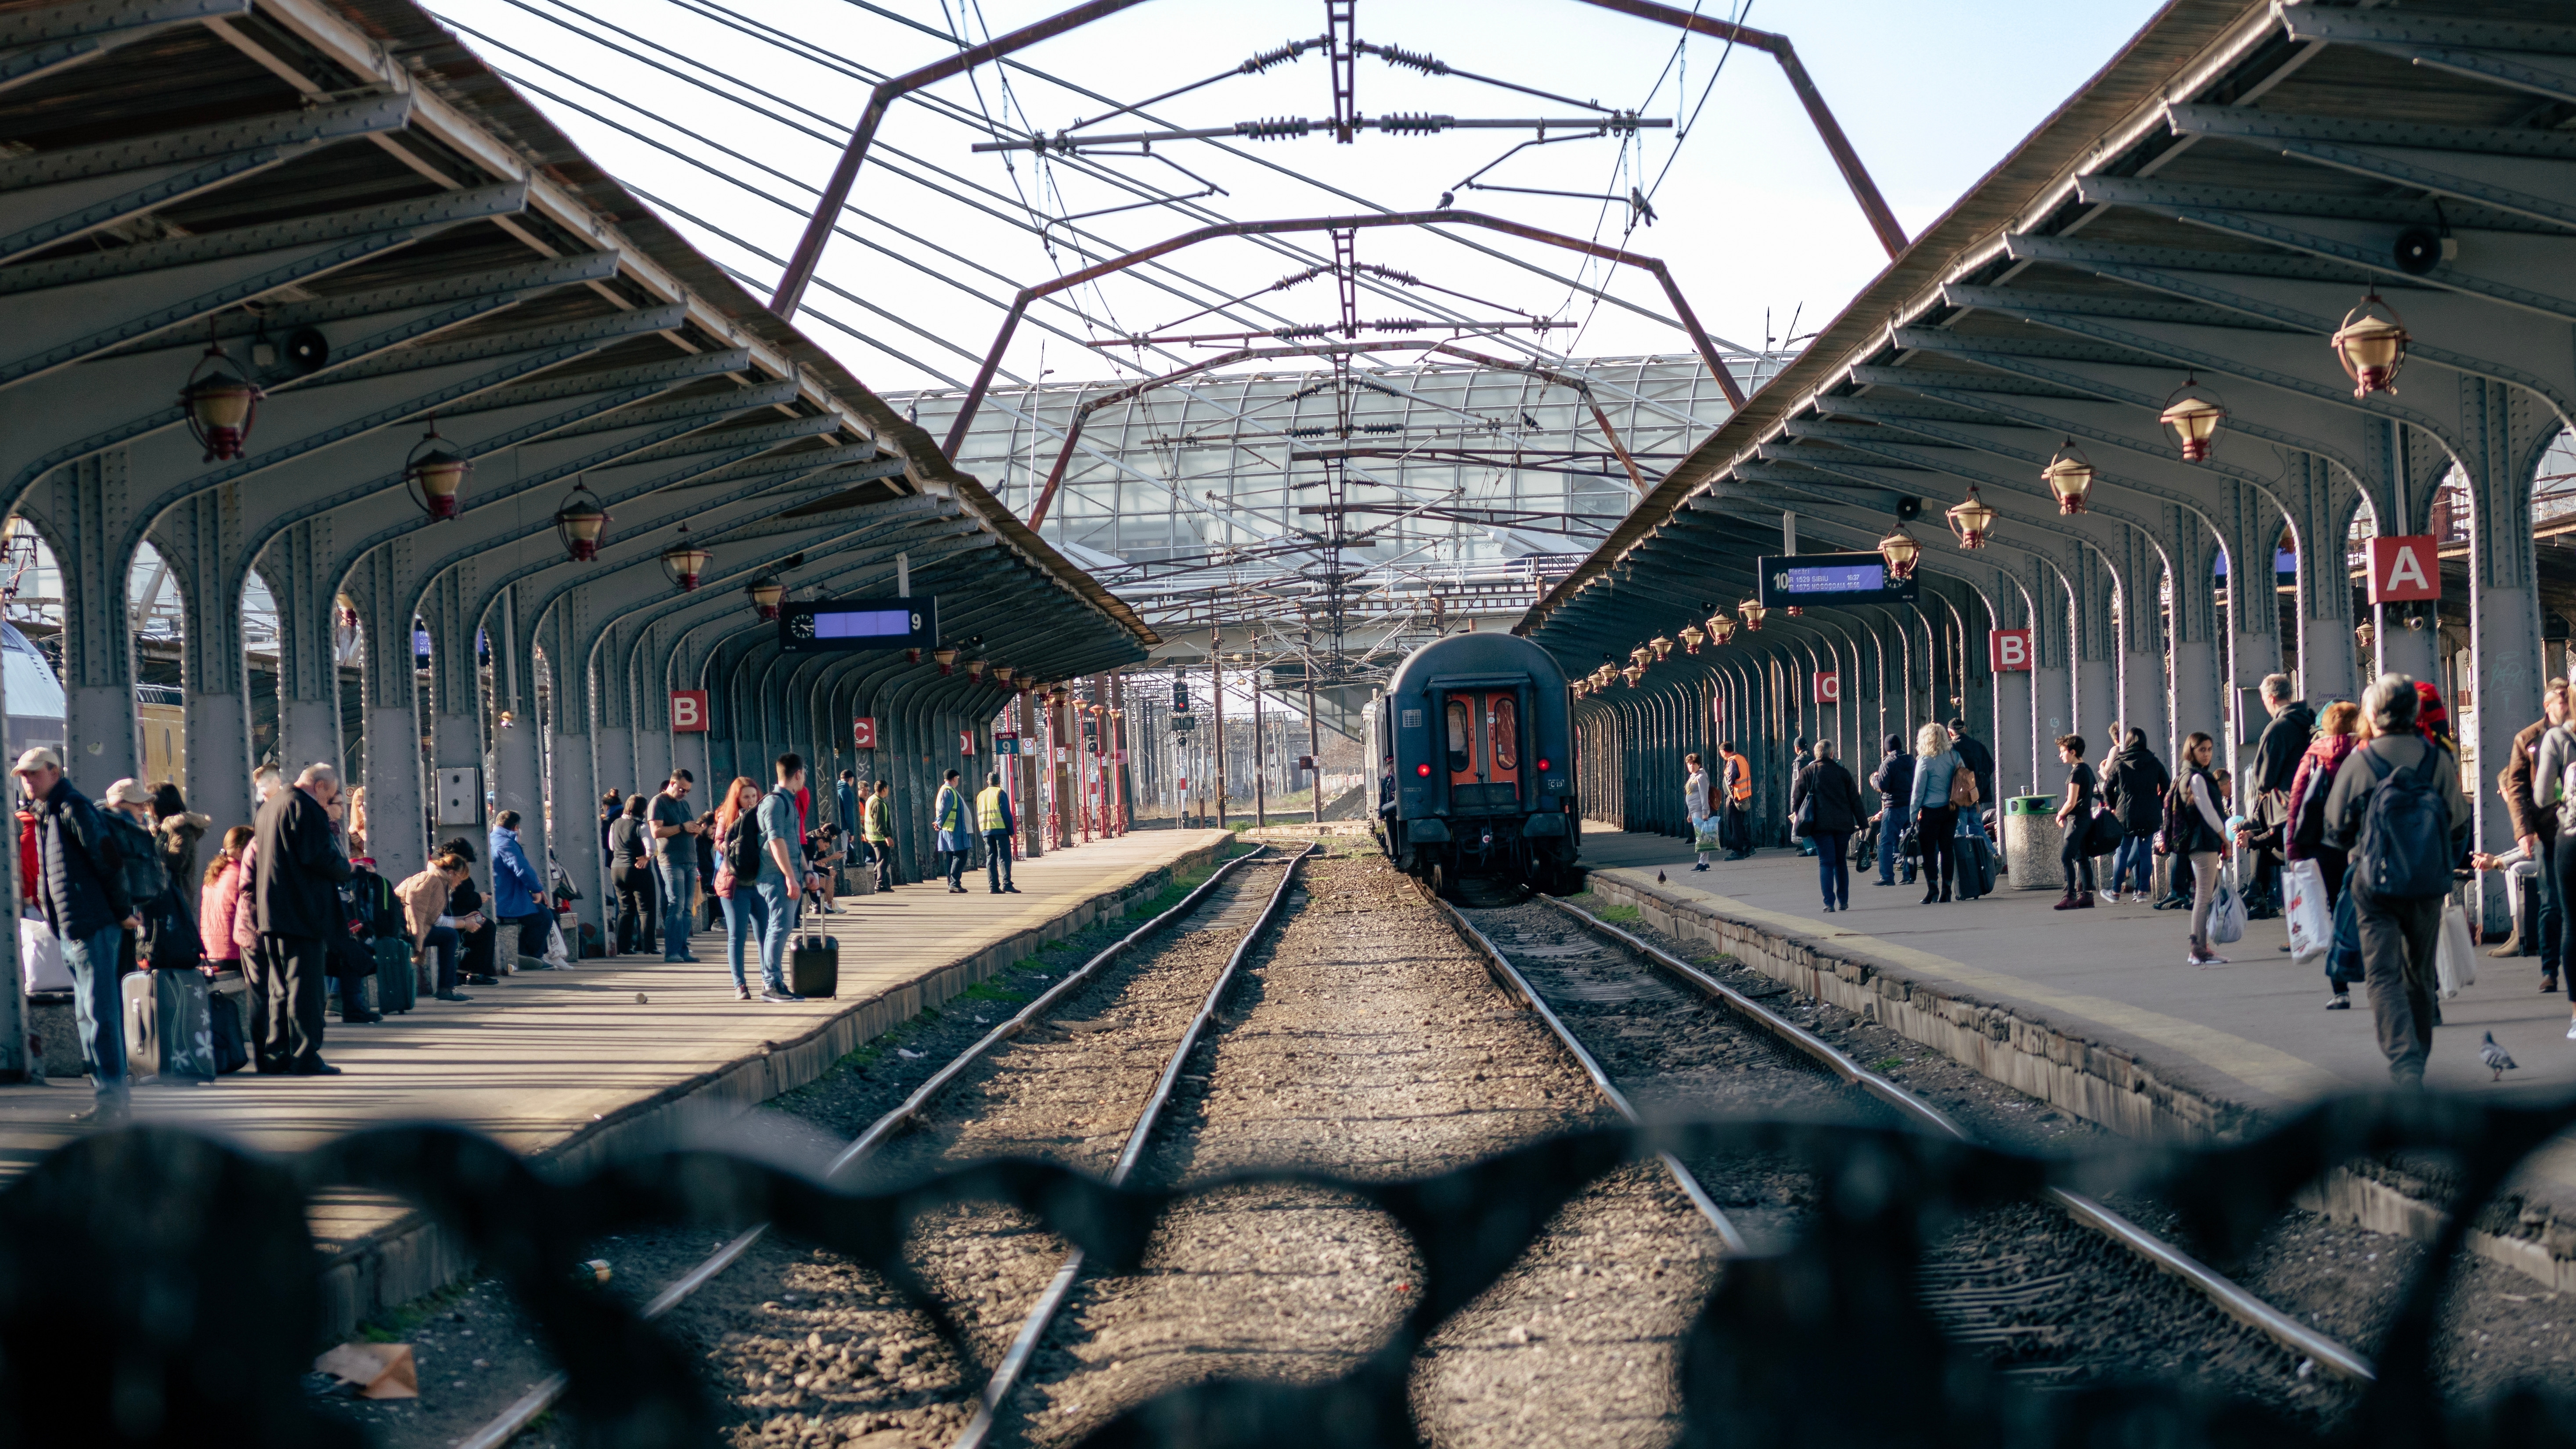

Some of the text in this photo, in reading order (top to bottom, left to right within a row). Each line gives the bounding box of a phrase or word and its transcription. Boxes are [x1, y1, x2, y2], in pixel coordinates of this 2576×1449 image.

[2386, 546, 2429, 591] A
[1773, 573, 1788, 589] 10
[912, 613, 921, 630] 9
[2001, 636, 2025, 664] B
[674, 697, 698, 725] B
[854, 722, 869, 744] C
[1002, 741, 1011, 754] 9
